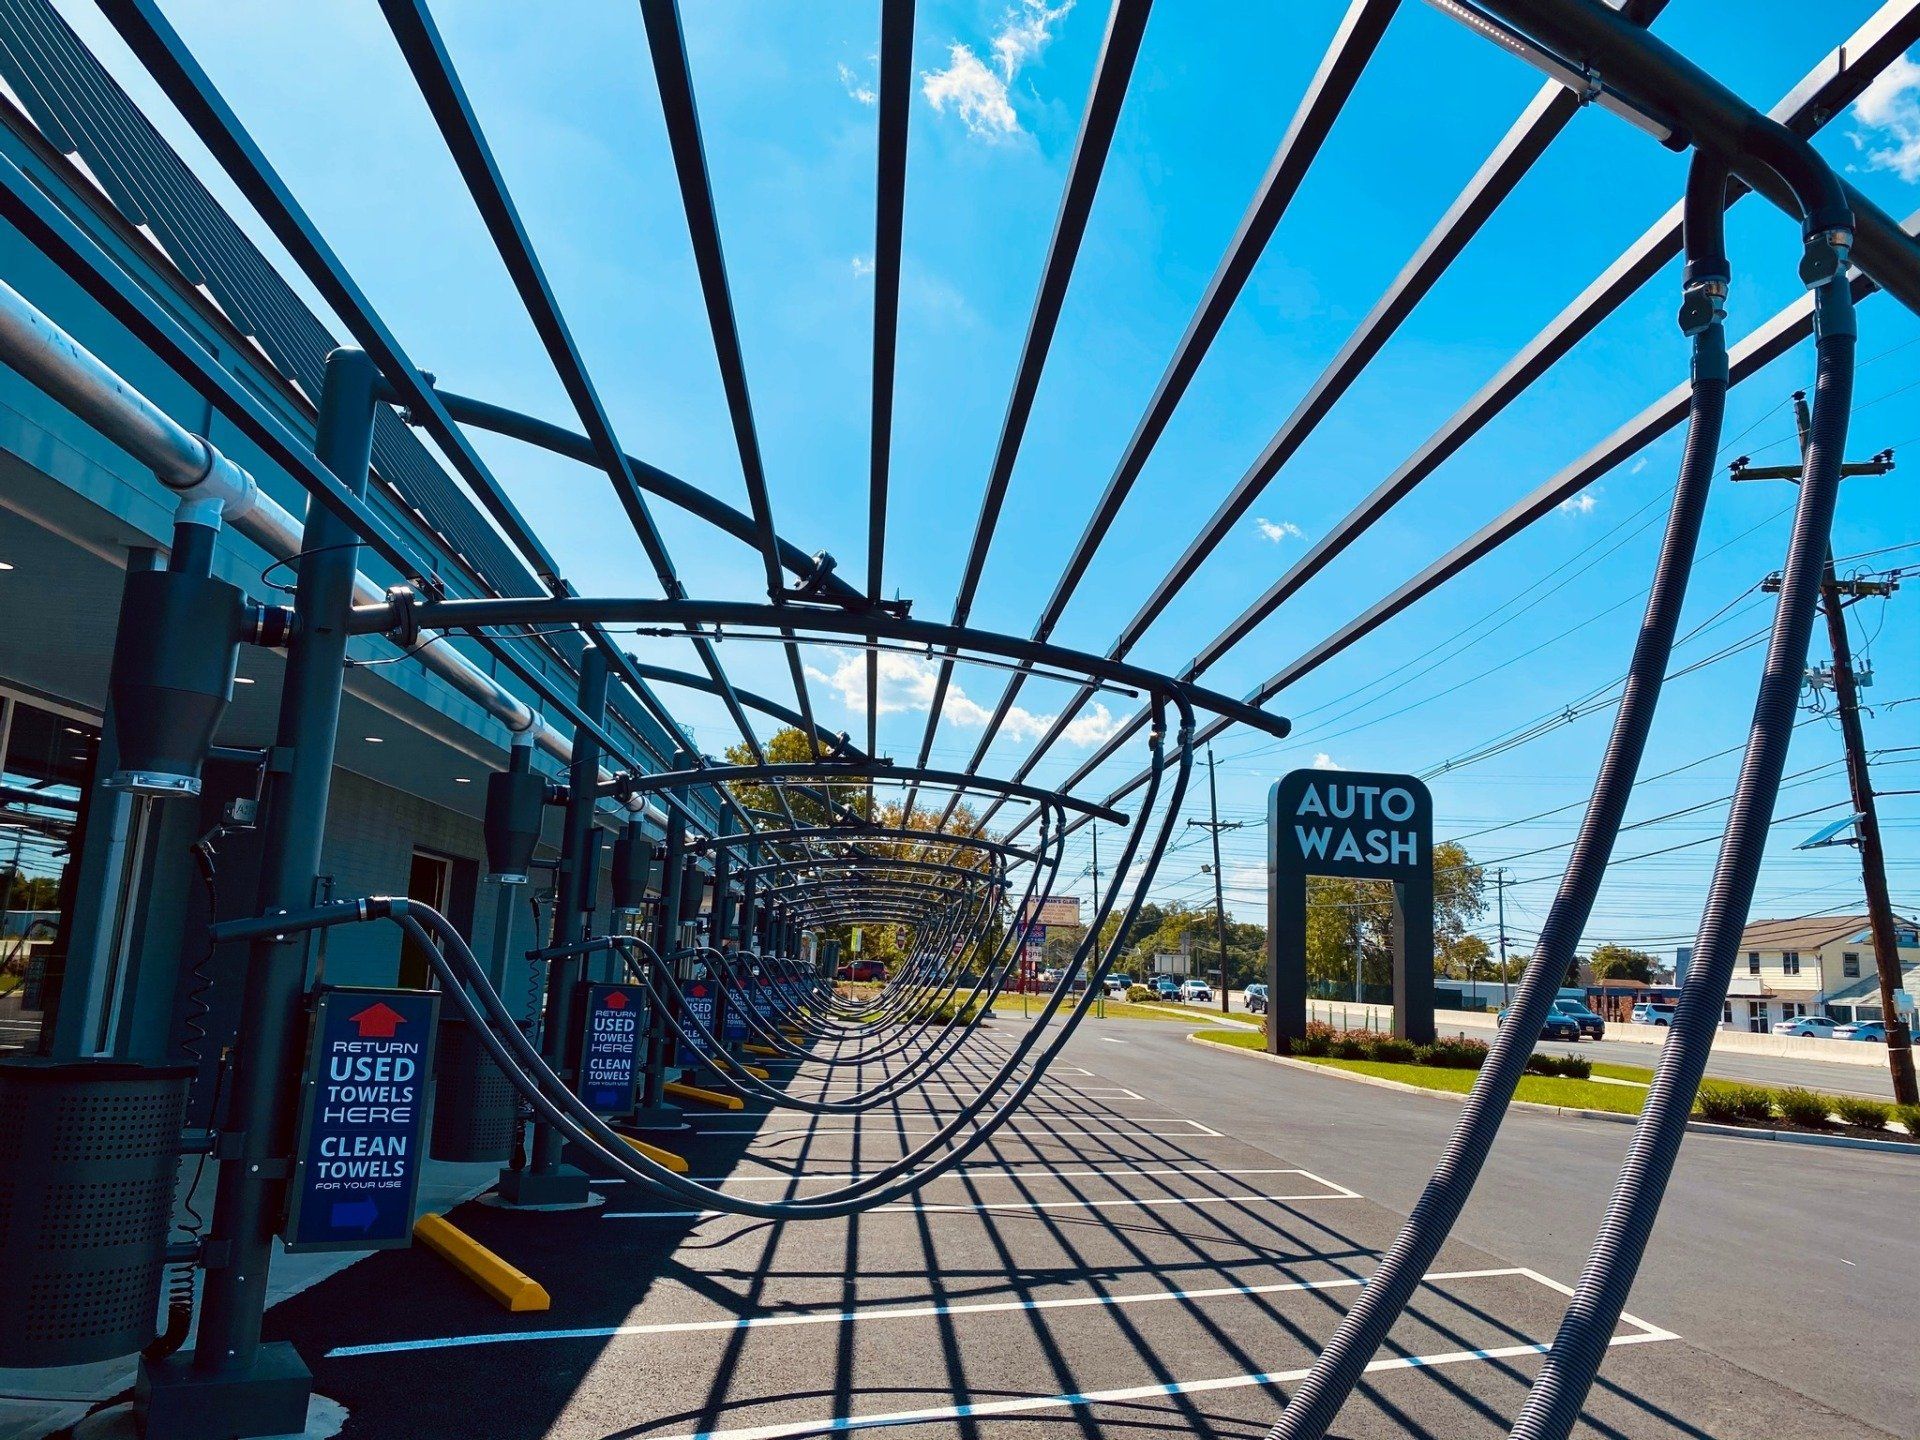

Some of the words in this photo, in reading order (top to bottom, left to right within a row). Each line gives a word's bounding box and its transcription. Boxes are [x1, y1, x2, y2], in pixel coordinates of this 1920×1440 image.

[1296, 782, 1416, 822] AUTO
[1295, 825, 1417, 866] WASH
[594, 1018, 635, 1032] USED
[593, 1033, 634, 1042] TOWELS
[333, 1041, 418, 1054] RETURN
[591, 1043, 633, 1053] HERE
[330, 1056, 416, 1082] USED
[590, 1058, 631, 1070] CLEAN
[589, 1070, 630, 1080] TOWELS
[328, 1086, 414, 1103] TOWELS
[323, 1107, 411, 1123] HERE
[320, 1136, 407, 1157] CLEAN
[317, 1160, 405, 1179] TOWELS
[315, 1182, 341, 1190] FOR
[343, 1181, 376, 1189] YOUR
[378, 1180, 402, 1189] USE
